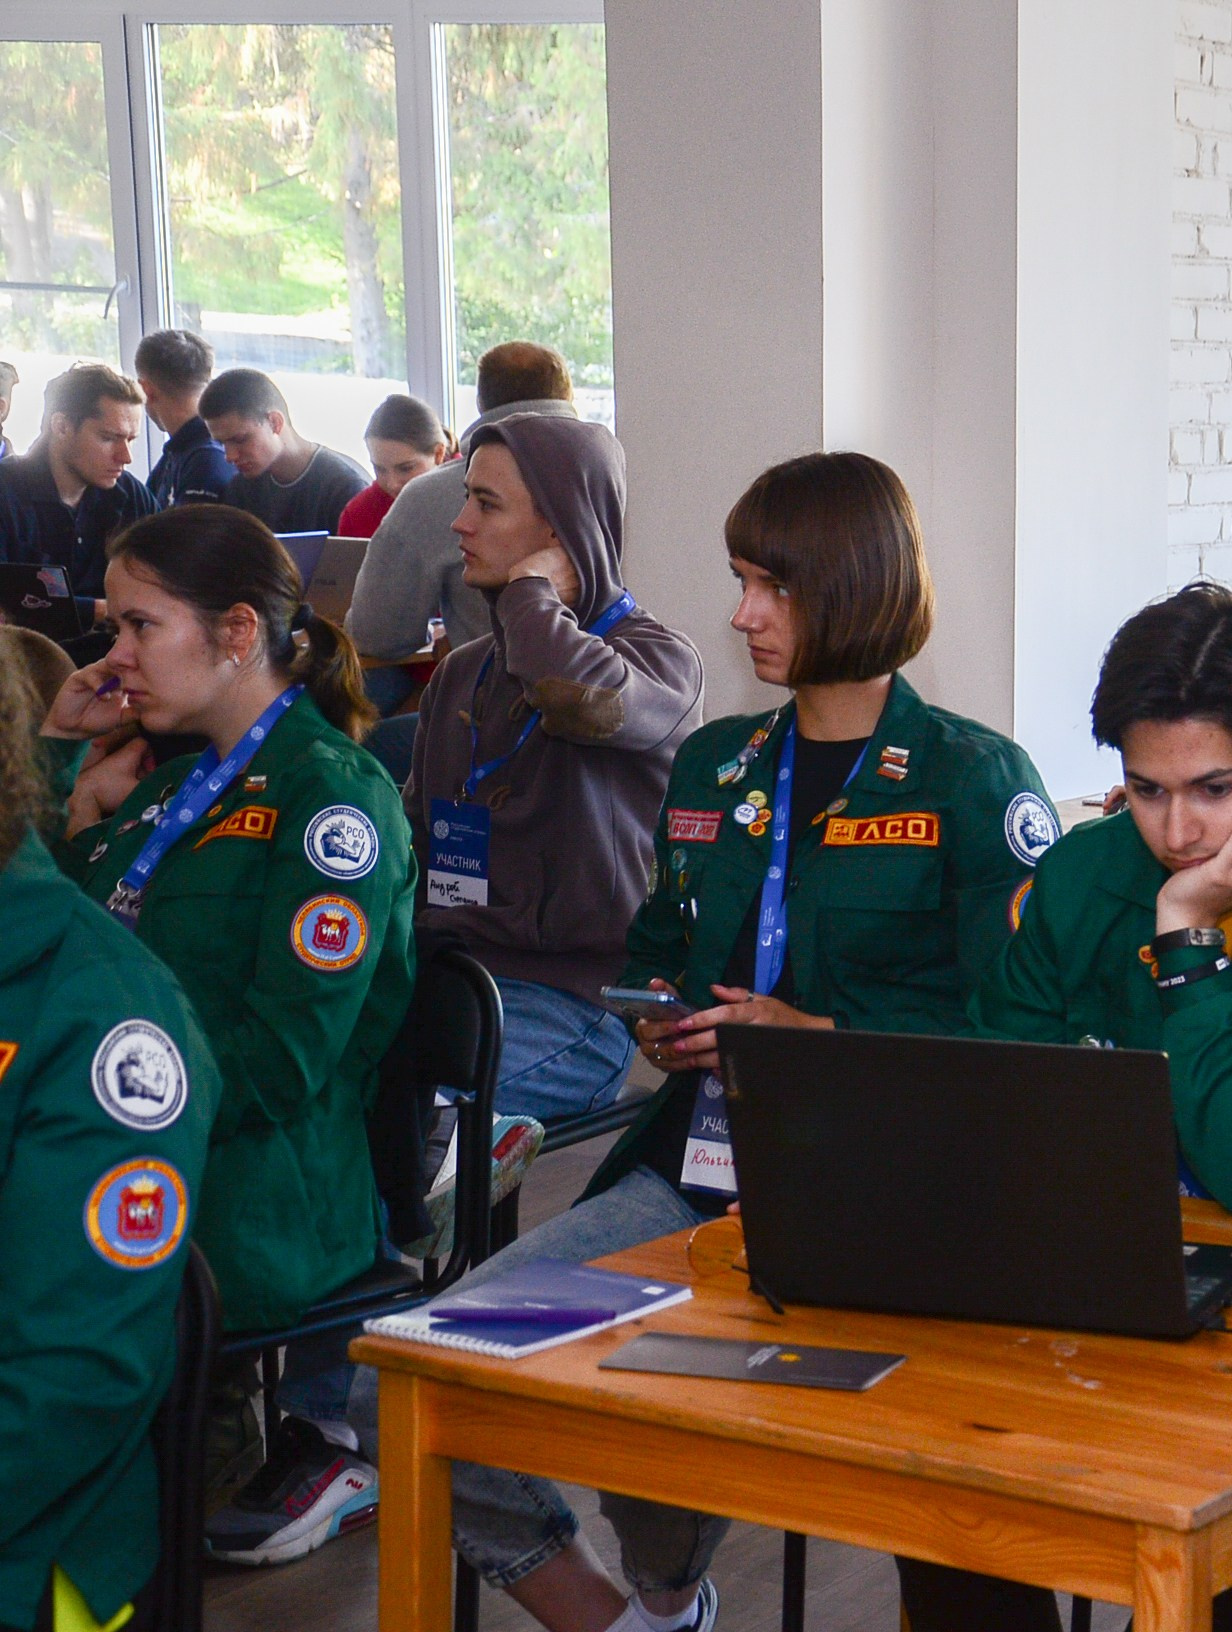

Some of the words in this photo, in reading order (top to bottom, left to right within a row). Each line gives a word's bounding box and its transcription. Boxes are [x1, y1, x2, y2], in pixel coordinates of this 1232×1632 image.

[346, 825, 365, 840] РСО
[861, 819, 928, 840] ЛСО
[436, 852, 481, 872] УЧАСТНИК
